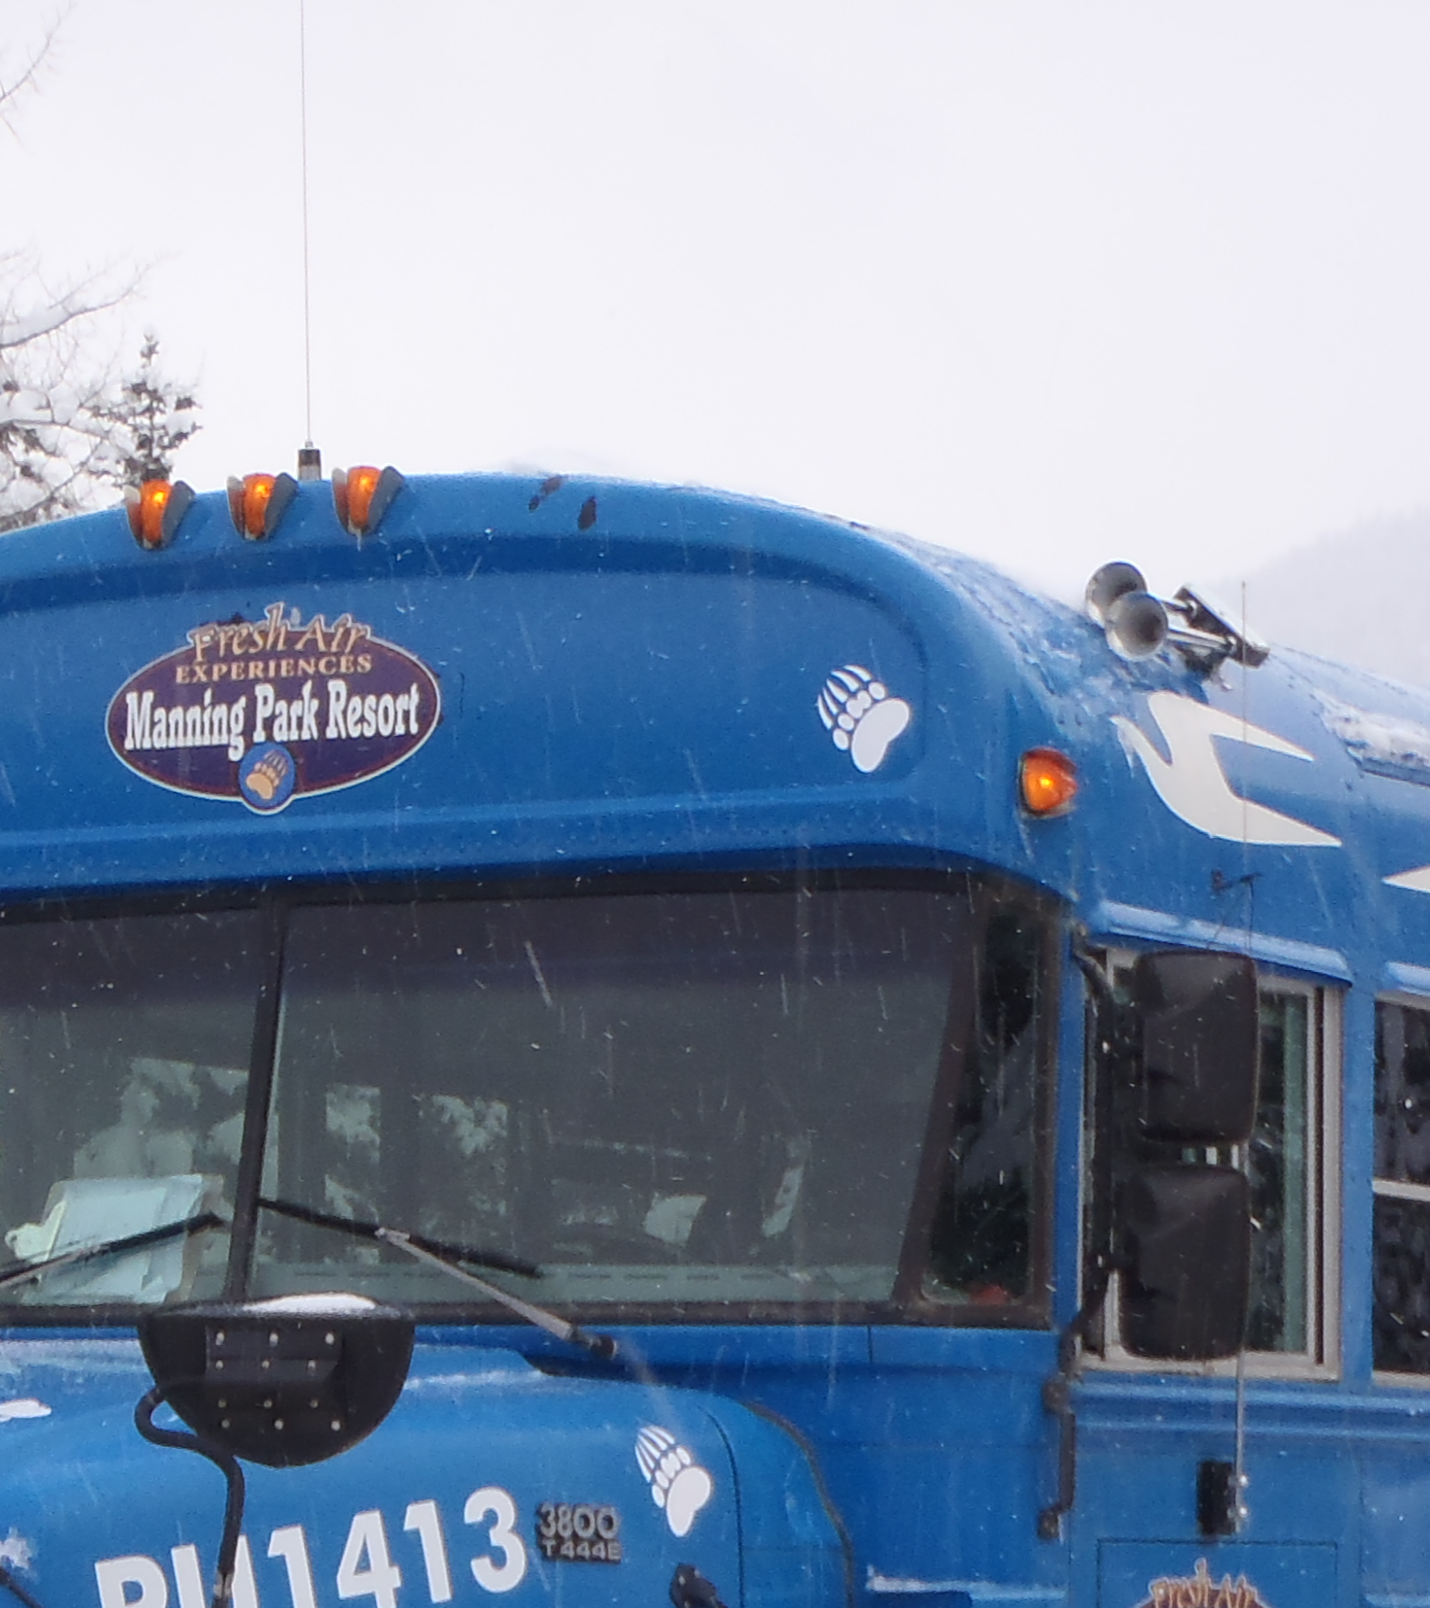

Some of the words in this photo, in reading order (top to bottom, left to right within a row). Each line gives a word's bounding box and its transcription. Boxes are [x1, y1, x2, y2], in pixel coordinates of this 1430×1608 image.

[192, 604, 289, 662] Fresh
[295, 613, 368, 654] Air
[175, 654, 373, 685] EXPERIENCES
[124, 689, 246, 762] Manning
[253, 680, 319, 744] Park
[326, 679, 420, 740] Resort
[540, 1502, 620, 1540] 3800
